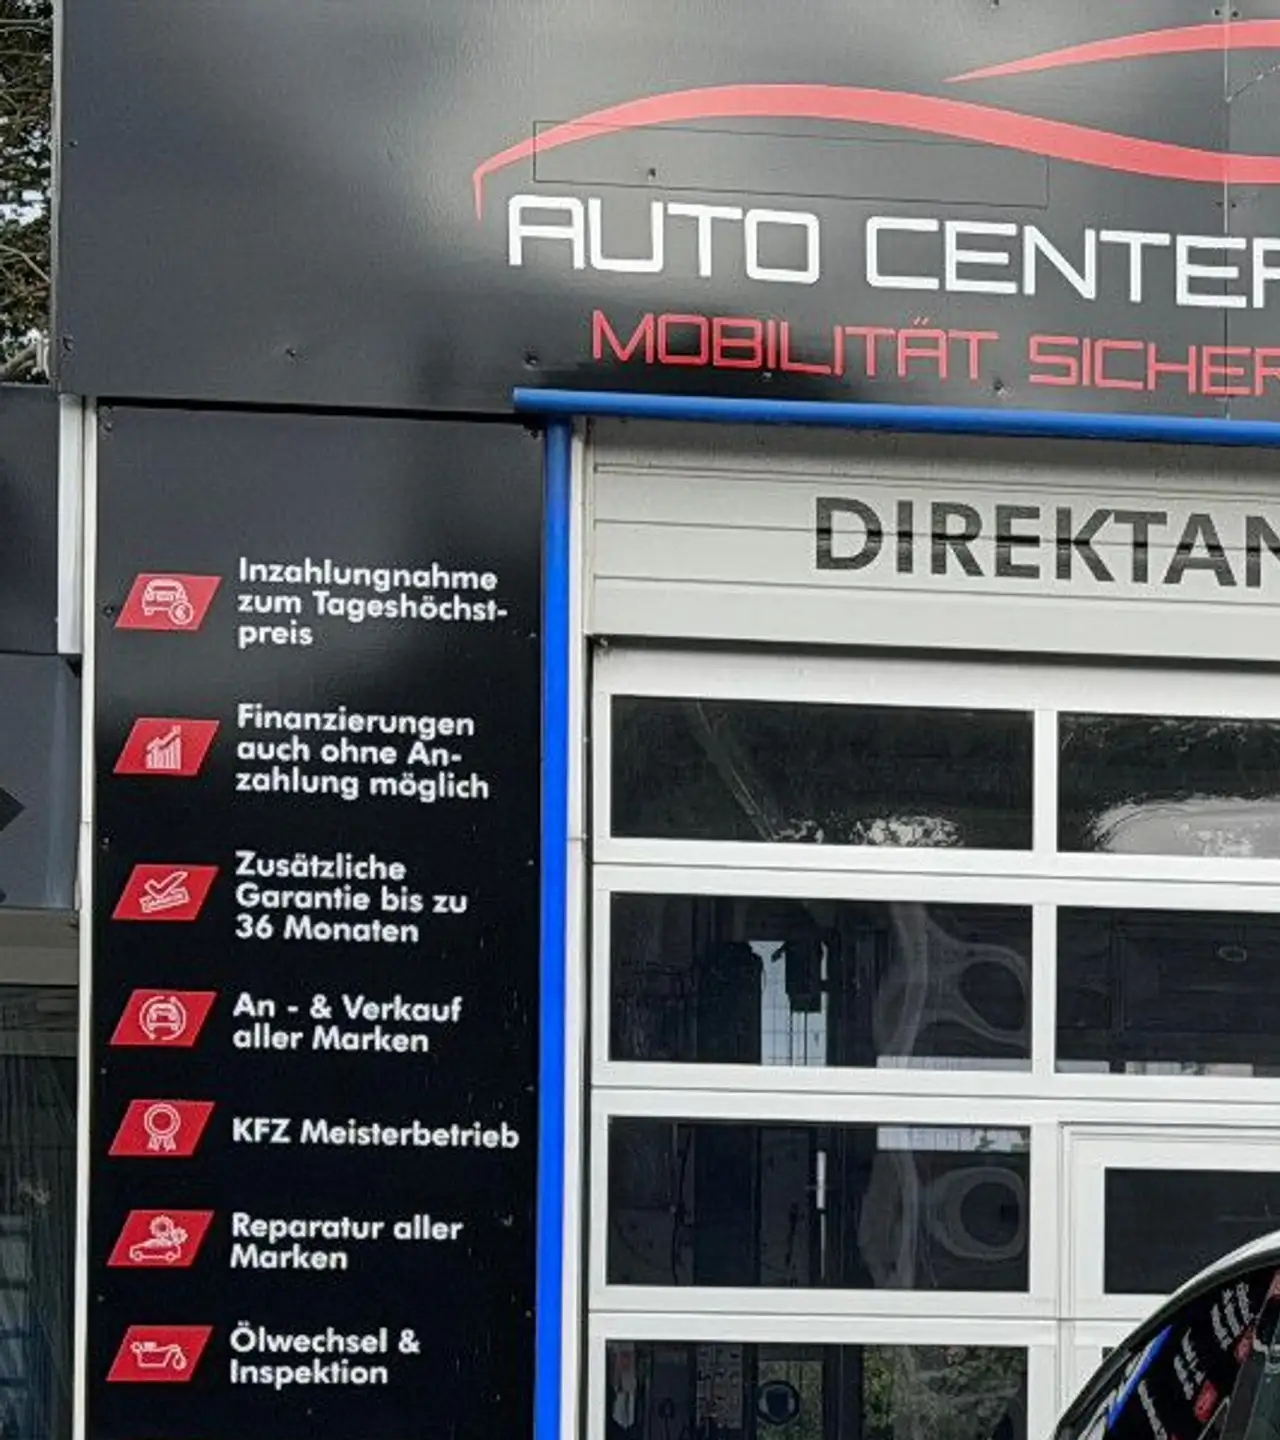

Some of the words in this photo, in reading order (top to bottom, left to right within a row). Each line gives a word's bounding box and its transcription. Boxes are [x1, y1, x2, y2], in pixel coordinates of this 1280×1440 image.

[507, 194, 822, 284] AUTO
[593, 310, 999, 380] MOBILITÄT
[239, 557, 498, 591] Inzahlungnahme
[237, 593, 303, 615] zum
[312, 591, 508, 622] Tageshöchst-
[238, 619, 314, 650] preis
[238, 702, 474, 739] Finanzierungen
[237, 735, 310, 762] auch
[320, 736, 397, 765] ohne
[407, 741, 462, 767] An-
[235, 767, 359, 801] zahlung
[369, 771, 489, 803] möglich
[235, 850, 407, 881] Zusätzliche
[235, 883, 371, 911] Garantie
[381, 885, 424, 913] bis
[432, 895, 467, 914] zu
[235, 913, 274, 940] 36
[283, 915, 419, 943] Monaten
[232, 992, 275, 1018] An
[309, 993, 332, 1019] &
[342, 994, 463, 1022] Verkauf
[232, 1024, 304, 1050] aller
[312, 1025, 429, 1053] Marken
[232, 1117, 291, 1144] KFZ
[300, 1118, 520, 1149] Meisterbetrieb
[232, 1212, 385, 1242] Reparatur
[393, 1215, 464, 1240] aller
[230, 1243, 348, 1270] Marken
[230, 1321, 388, 1354] Ölwechsel
[398, 1328, 420, 1354] &
[230, 1357, 388, 1391] Inspektion
